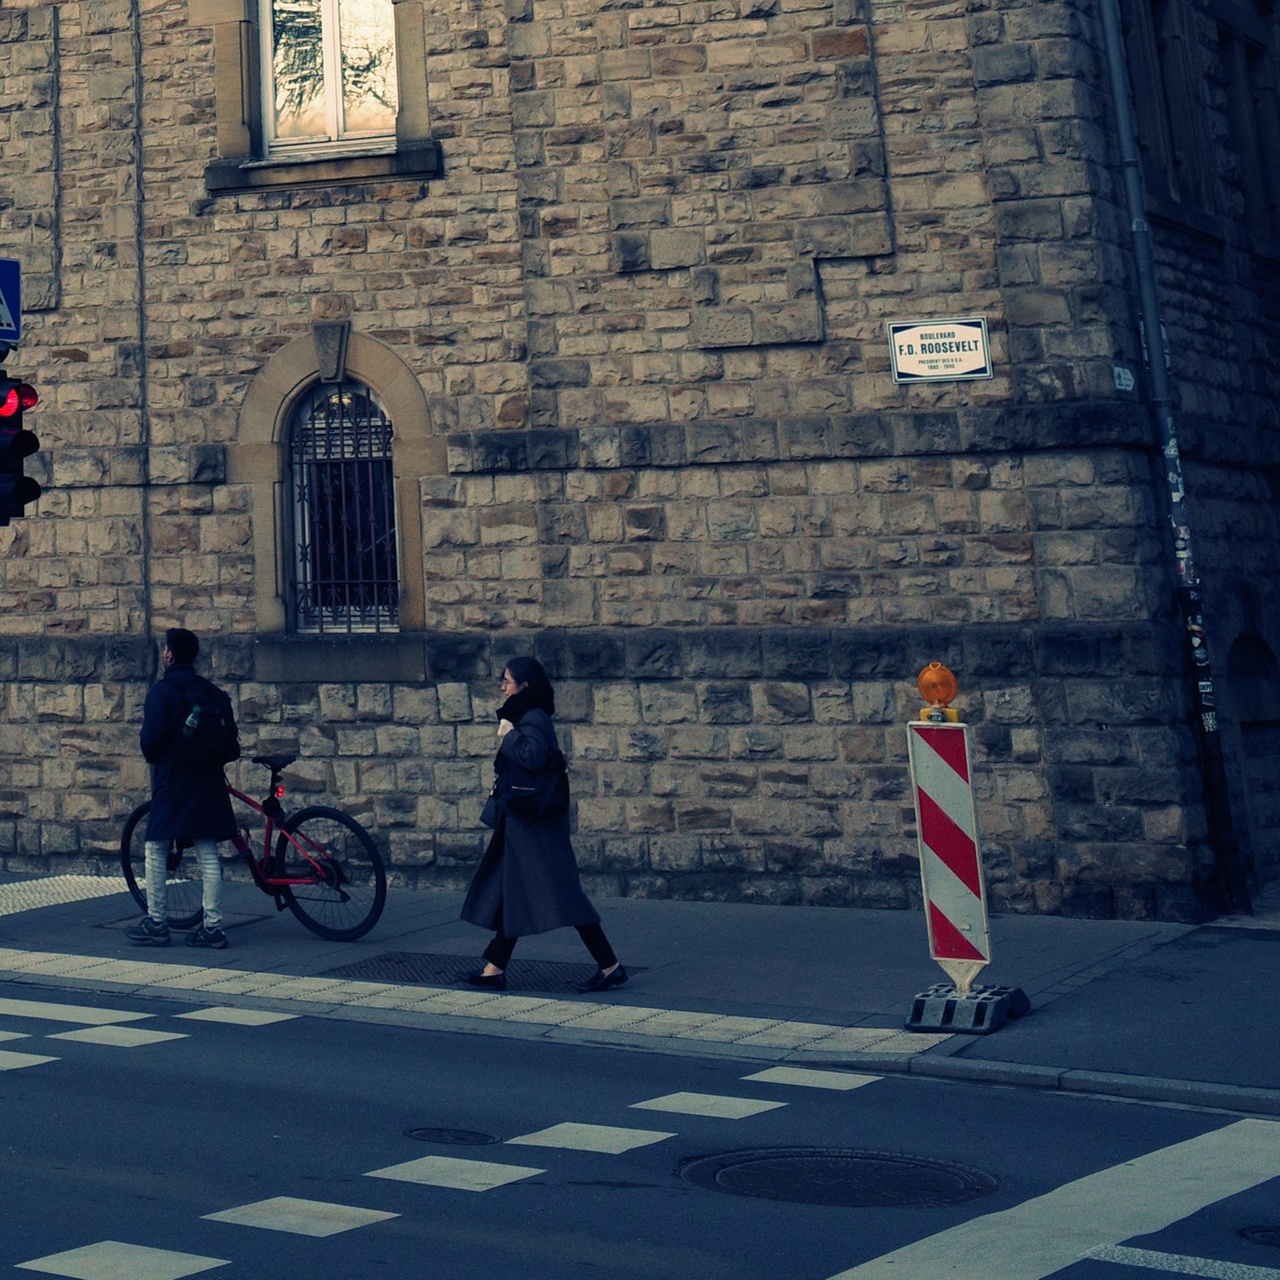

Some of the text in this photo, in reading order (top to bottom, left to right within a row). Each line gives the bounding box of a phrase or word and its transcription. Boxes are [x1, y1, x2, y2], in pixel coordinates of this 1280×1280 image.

[920, 332, 955, 340] BOULEVARD
[899, 340, 979, 356] F.D. ROOSEVELT
